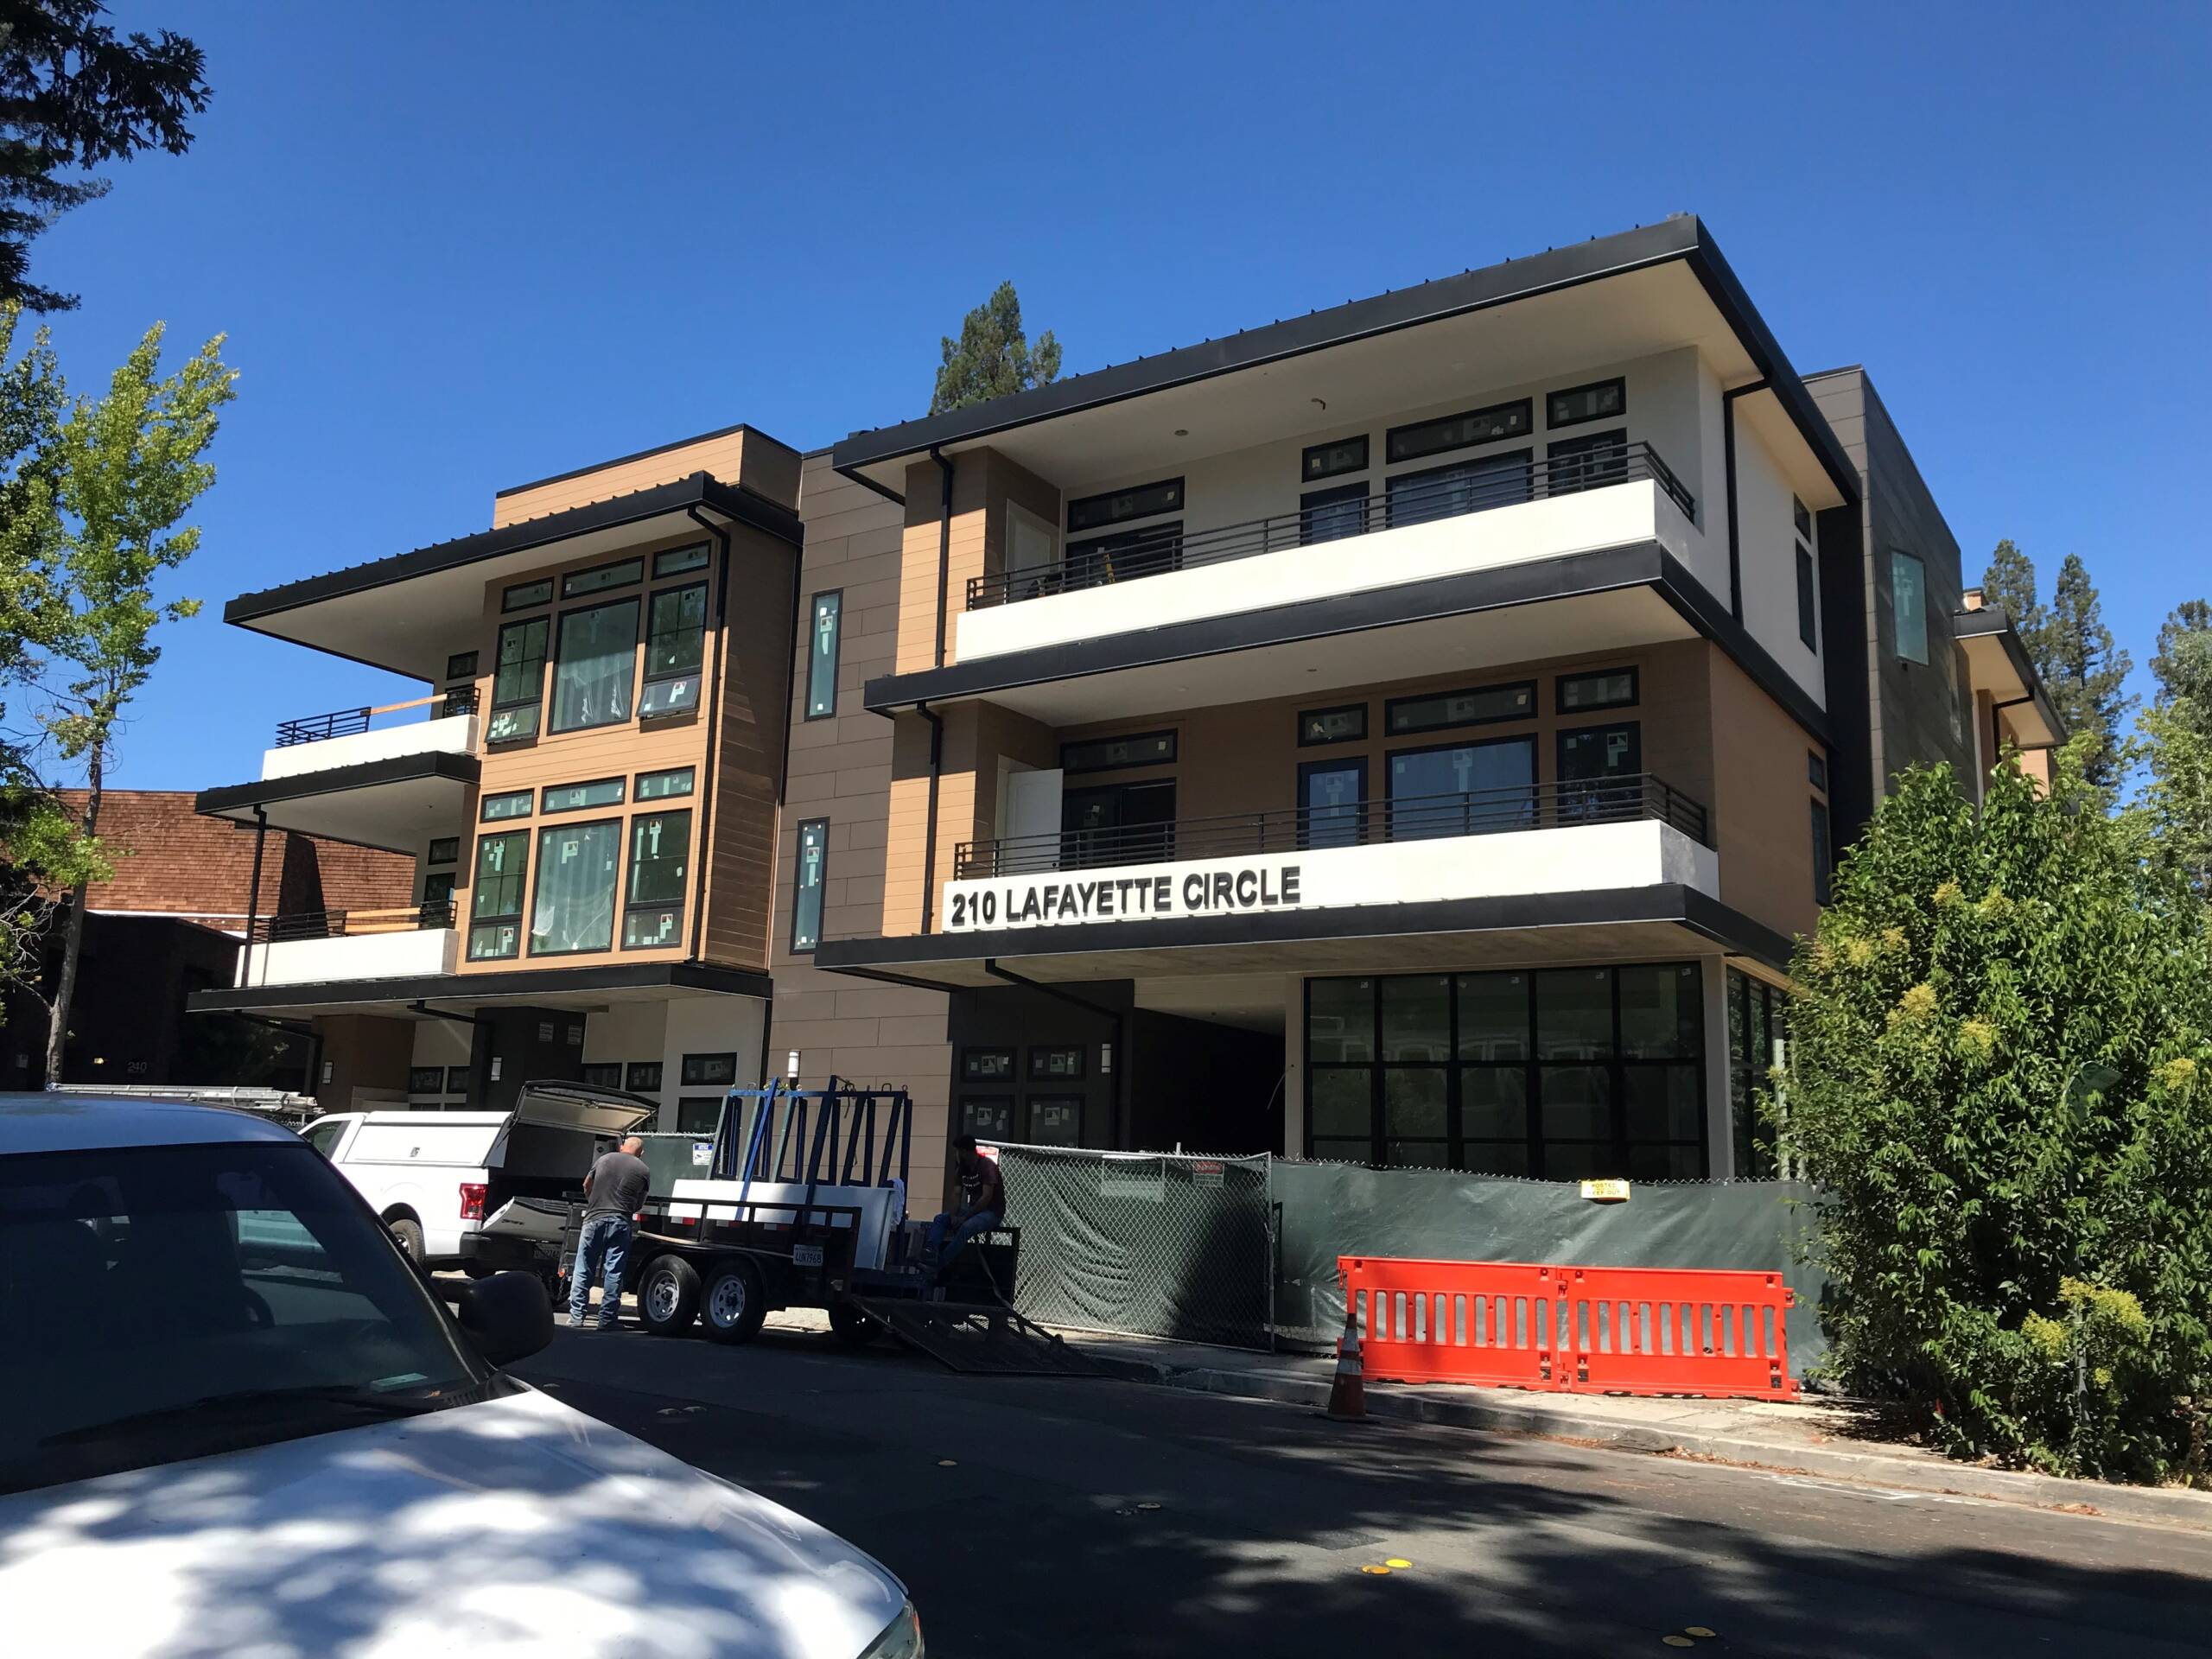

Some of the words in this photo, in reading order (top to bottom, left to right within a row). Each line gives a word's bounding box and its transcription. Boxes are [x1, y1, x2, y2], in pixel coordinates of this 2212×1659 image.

[951, 890, 996, 925] 210
[1007, 875, 1172, 922] LAFAYETTE
[1183, 866, 1300, 910] CIRCLE
[127, 1062, 147, 1072] 240
